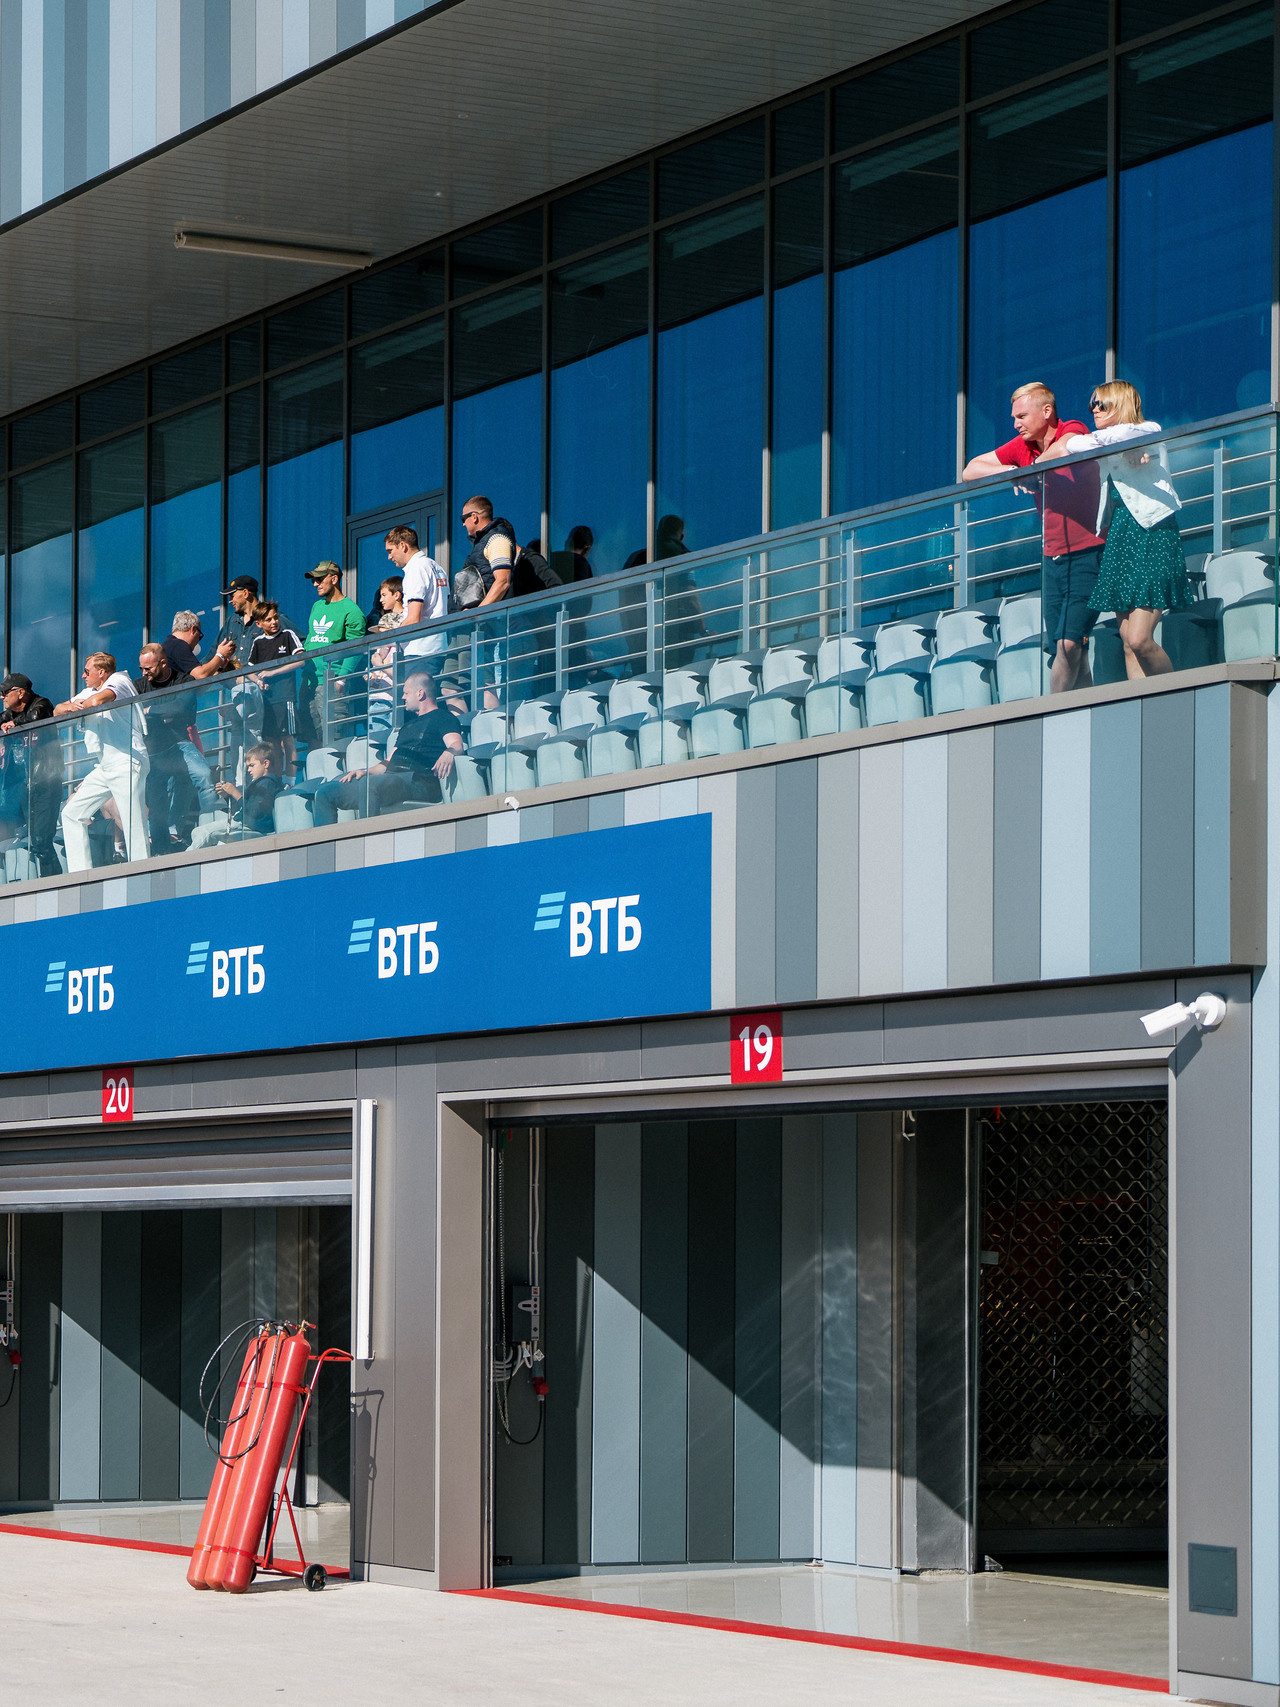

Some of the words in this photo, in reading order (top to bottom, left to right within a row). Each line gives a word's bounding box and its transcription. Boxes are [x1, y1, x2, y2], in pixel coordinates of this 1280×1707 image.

[378, 921, 439, 979] ВТБ
[569, 894, 642, 957] ВТБ
[67, 965, 115, 1015] ВТБ
[212, 944, 265, 998] ВТБ
[738, 1024, 774, 1072] 19
[105, 1077, 130, 1114] 20
